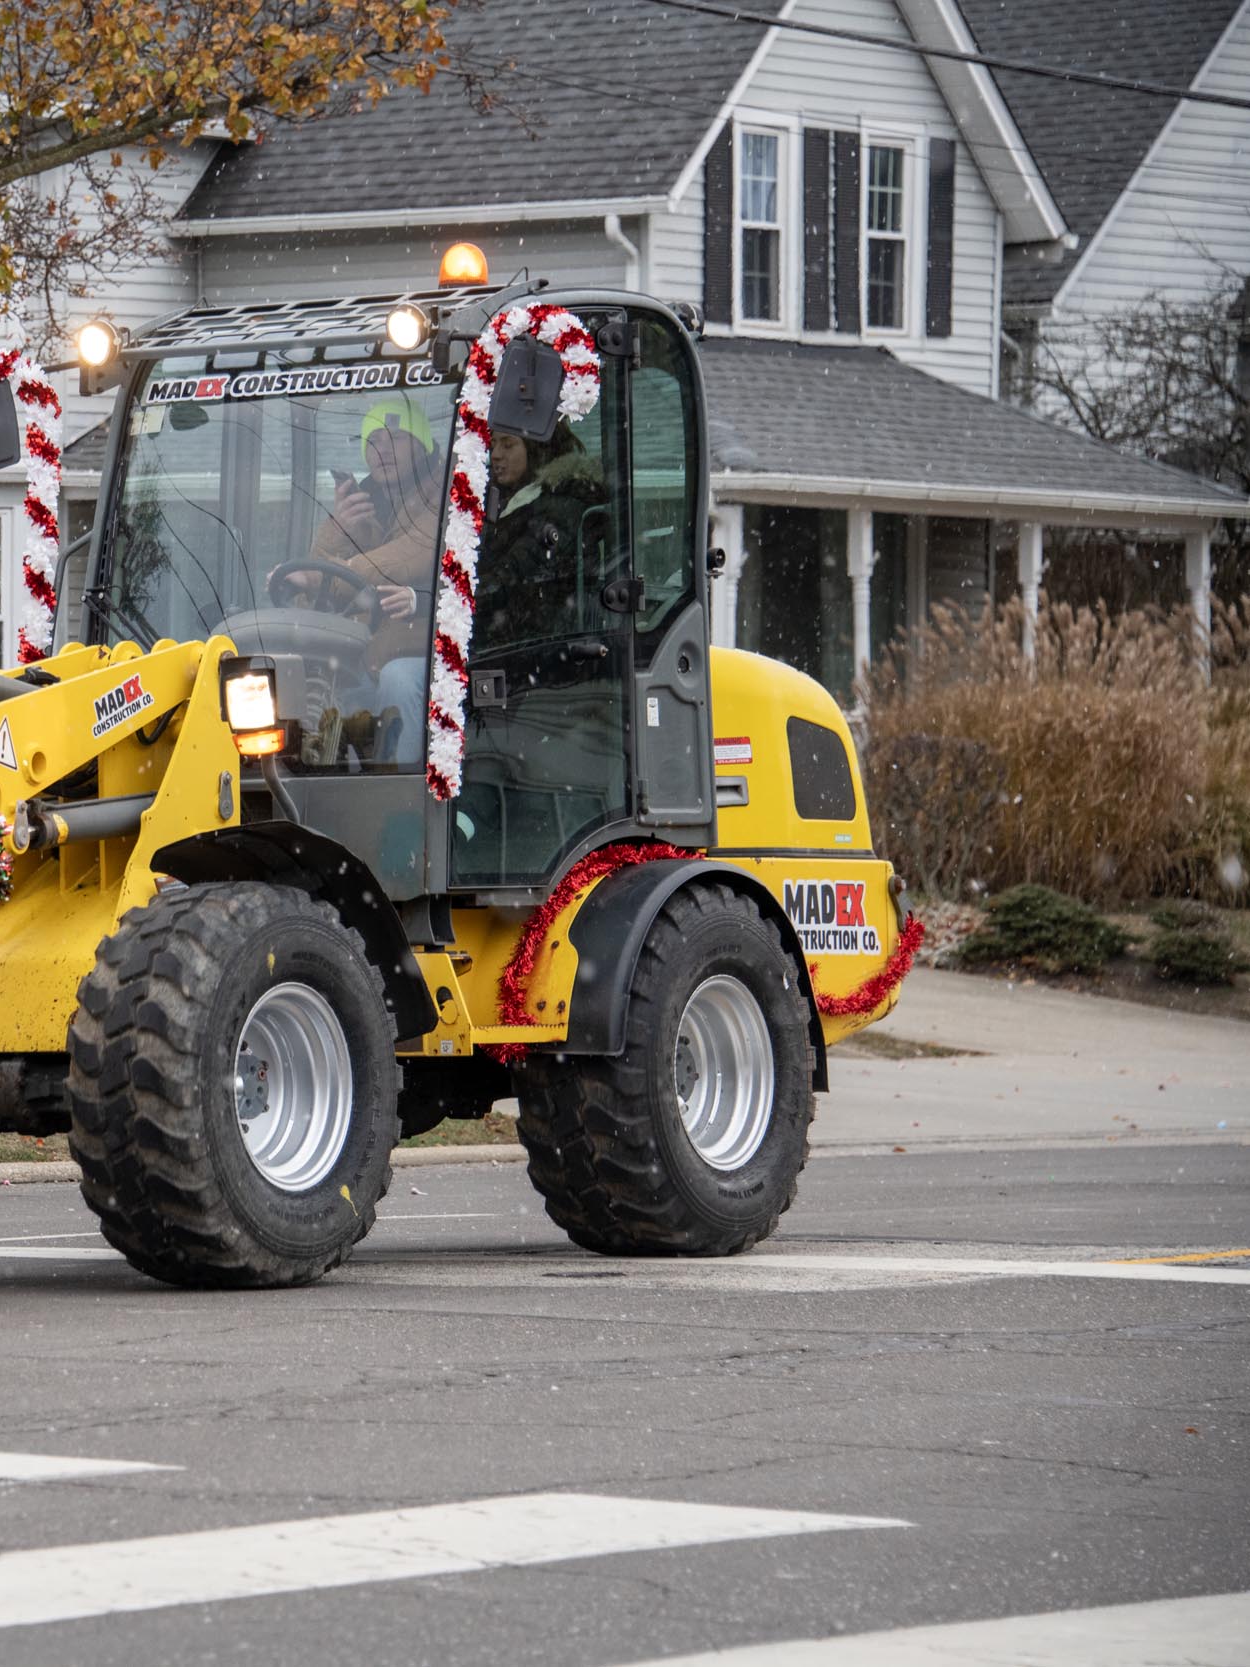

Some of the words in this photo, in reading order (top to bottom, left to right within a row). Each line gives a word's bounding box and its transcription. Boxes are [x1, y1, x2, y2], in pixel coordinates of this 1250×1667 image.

[148, 377, 228, 401] MADEX
[233, 366, 398, 395] CONSTRUCTION
[408, 364, 442, 383] CO.
[93, 701, 142, 737] CONSTRUCTION
[143, 693, 154, 706] CO.
[95, 675, 144, 721] MADEX
[785, 883, 865, 927] MADEX
[862, 931, 879, 951] CO.
